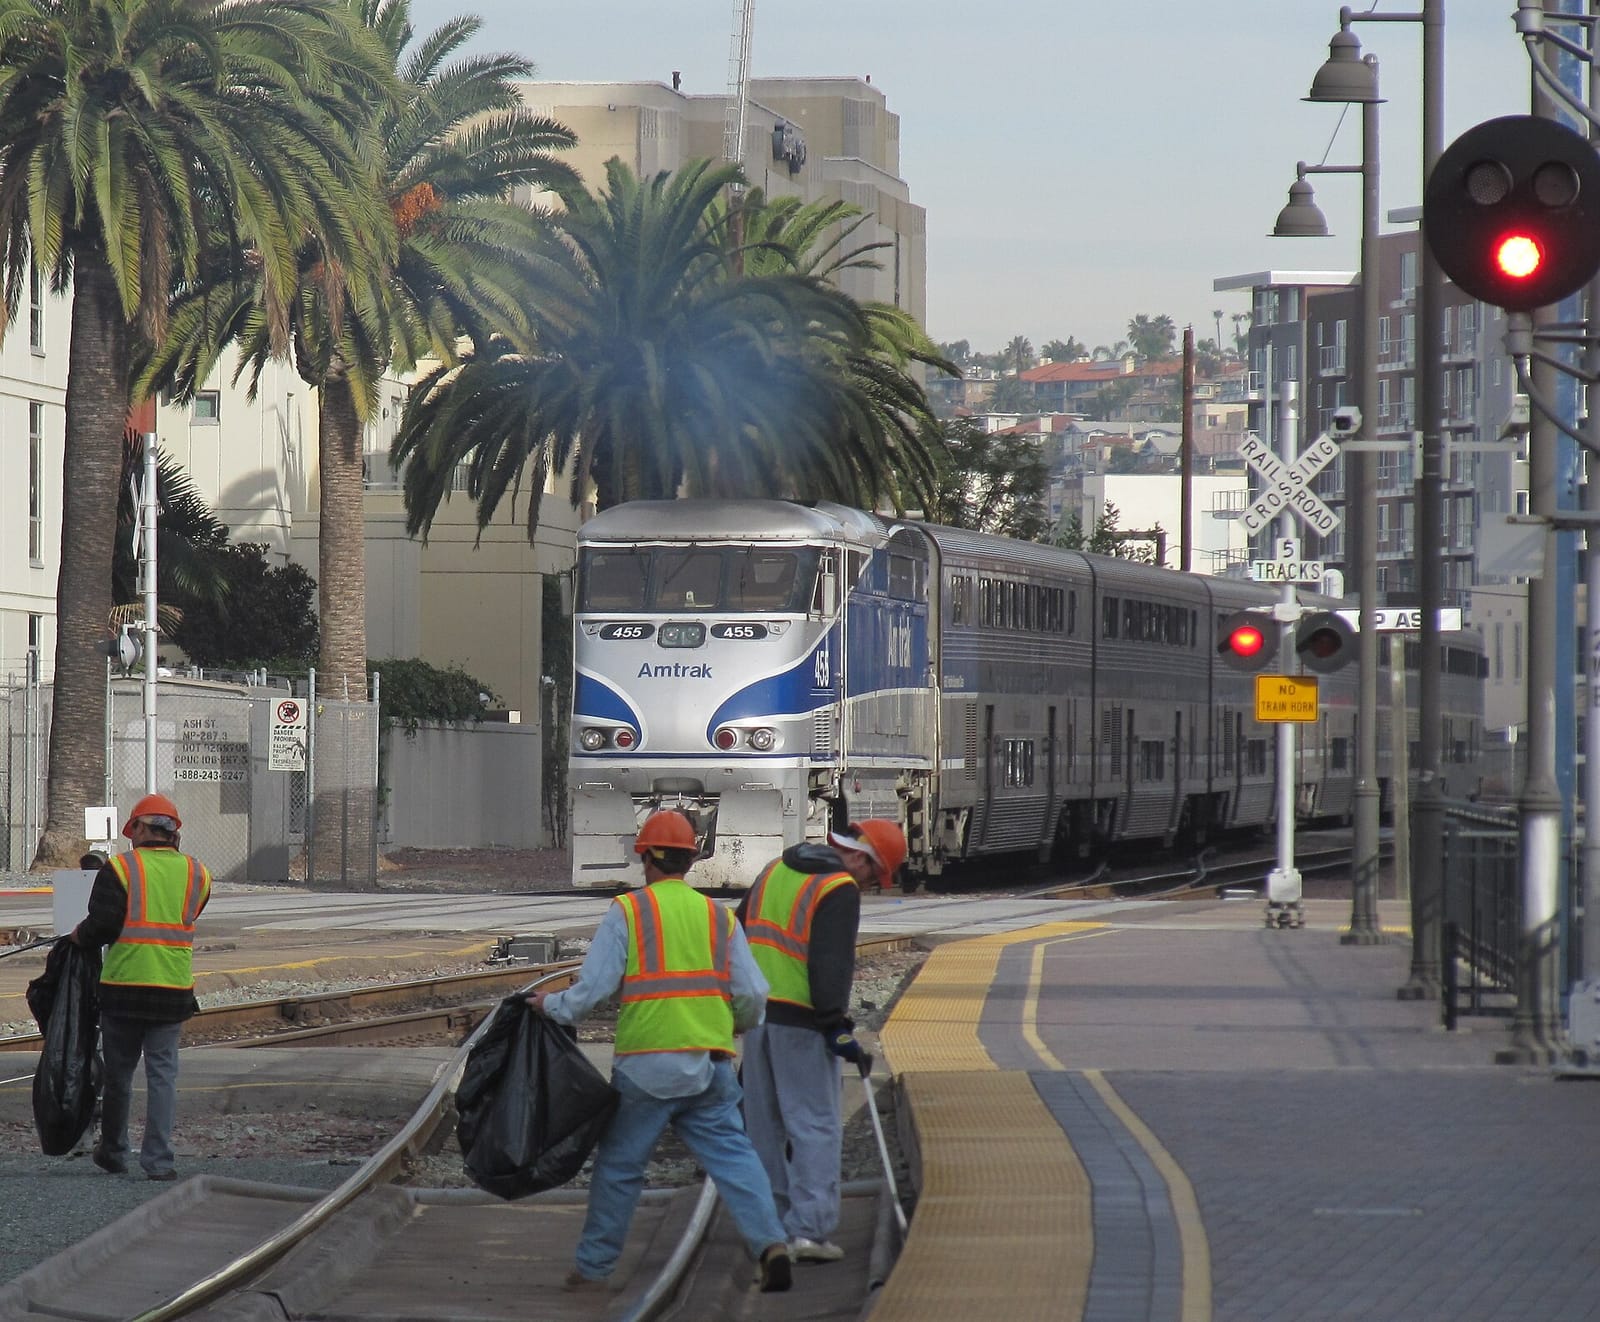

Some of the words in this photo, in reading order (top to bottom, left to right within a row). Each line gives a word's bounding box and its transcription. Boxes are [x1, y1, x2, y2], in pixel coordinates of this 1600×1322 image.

[1244, 441, 1333, 529] CROSSING
[1282, 540, 1295, 558] 5
[1256, 562, 1321, 580] TRACKS
[1395, 612, 1422, 628] AS
[612, 626, 643, 638] 455
[723, 626, 755, 638] 455
[637, 662, 713, 679] Amtrak
[814, 650, 830, 687] 455
[1279, 685, 1296, 695] NO
[1261, 701, 1287, 712] TRAIN
[1291, 701, 1314, 712] HORN
[183, 719, 202, 728] ASH
[182, 743, 201, 752] DOT
[174, 755, 199, 765] CPUC
[173, 770, 244, 781] 1-888-243-5247
